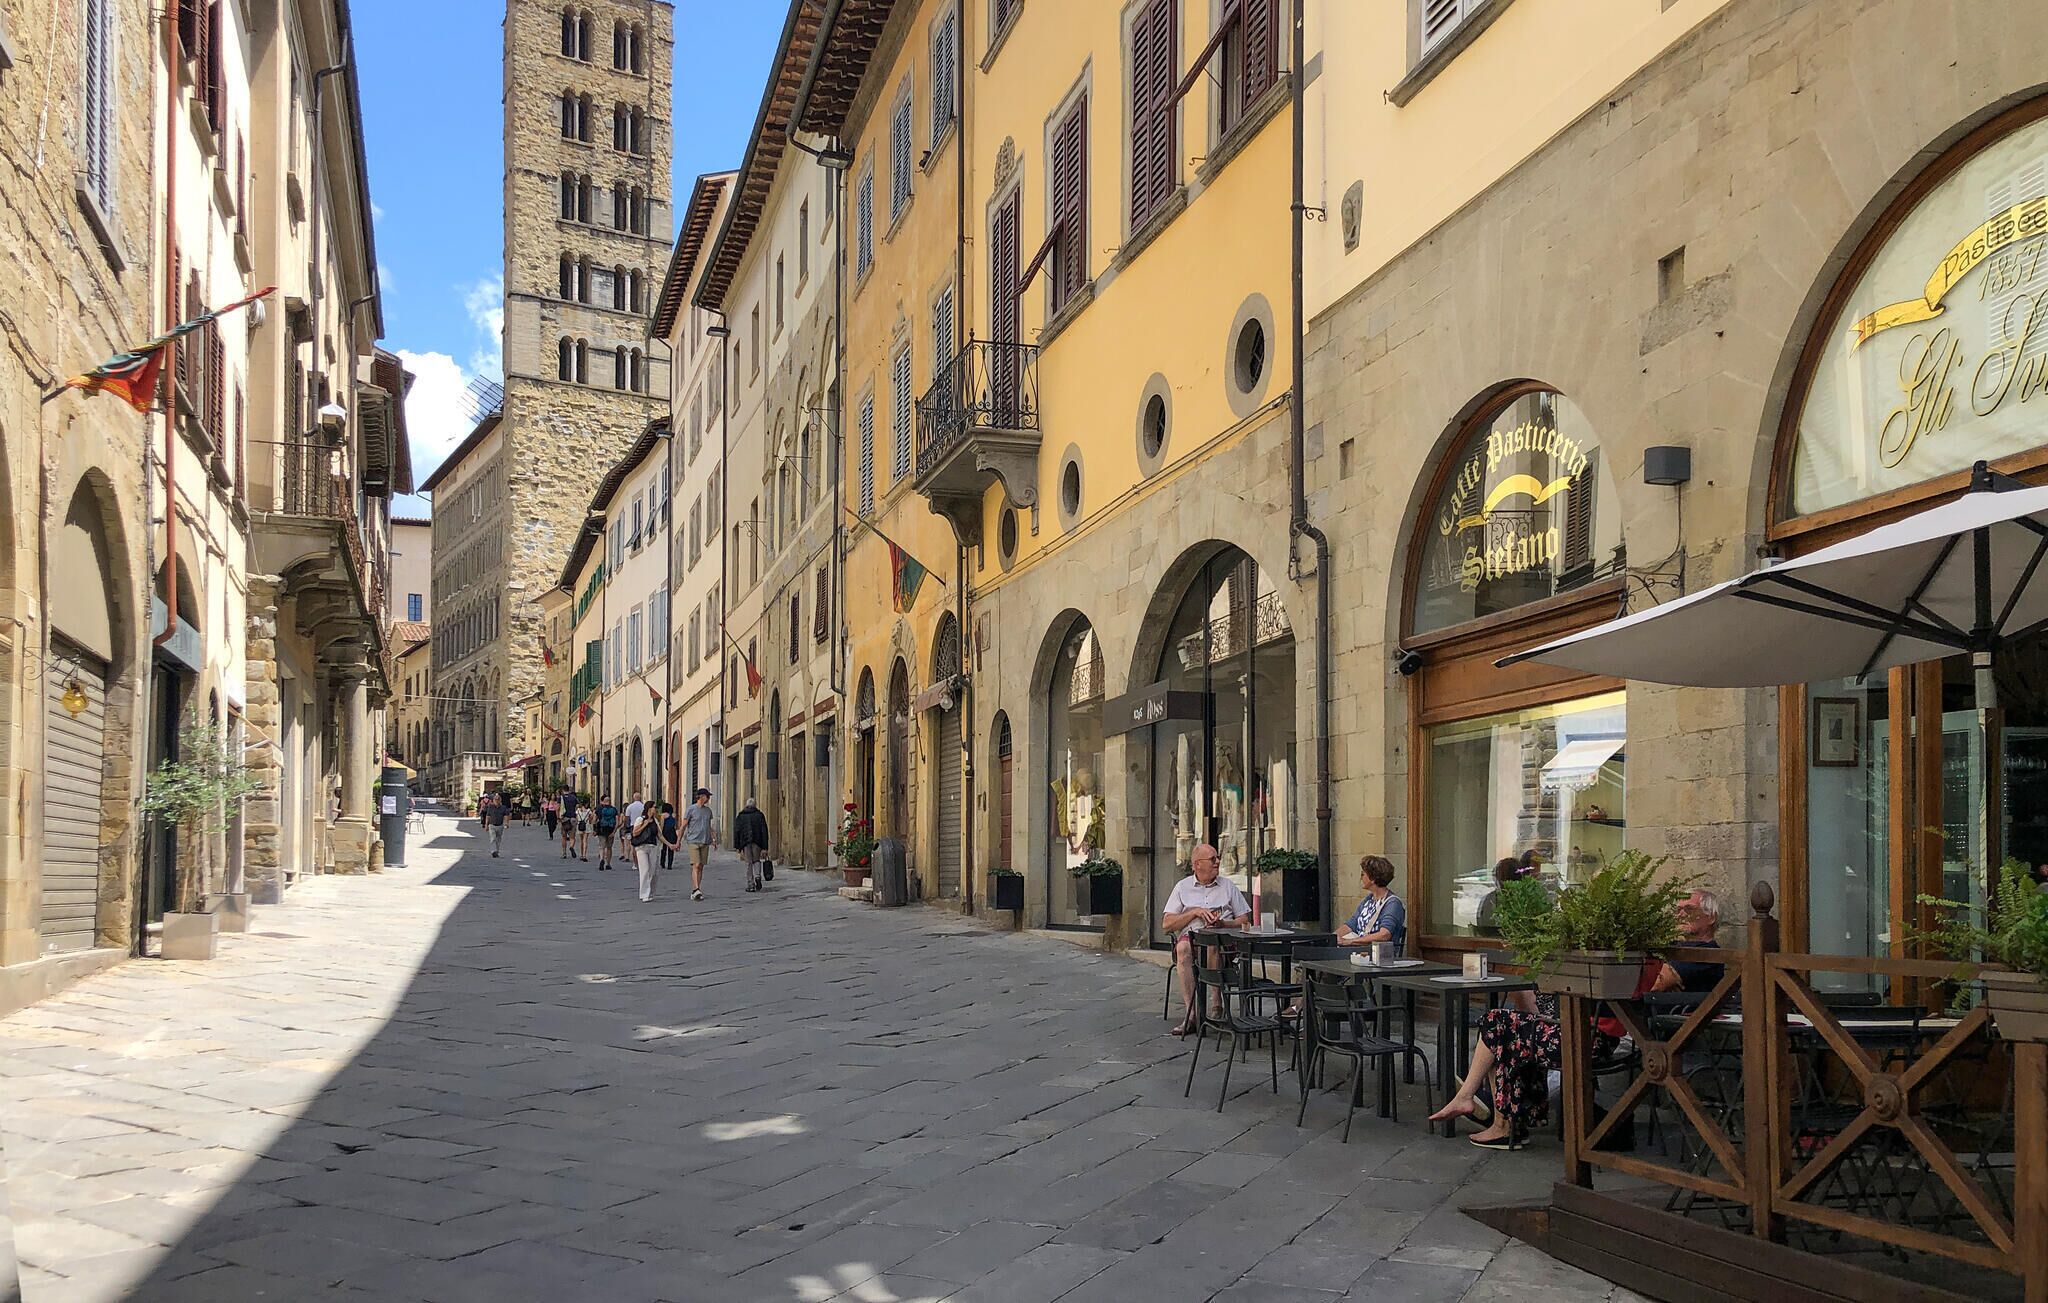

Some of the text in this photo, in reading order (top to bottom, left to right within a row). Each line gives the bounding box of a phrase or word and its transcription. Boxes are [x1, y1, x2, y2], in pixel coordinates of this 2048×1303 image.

[1979, 239, 2045, 302] 1857
[1879, 327, 1964, 469] Gli
[1486, 417, 1588, 481] Pasticceria
[1460, 526, 1559, 593] Stefano
